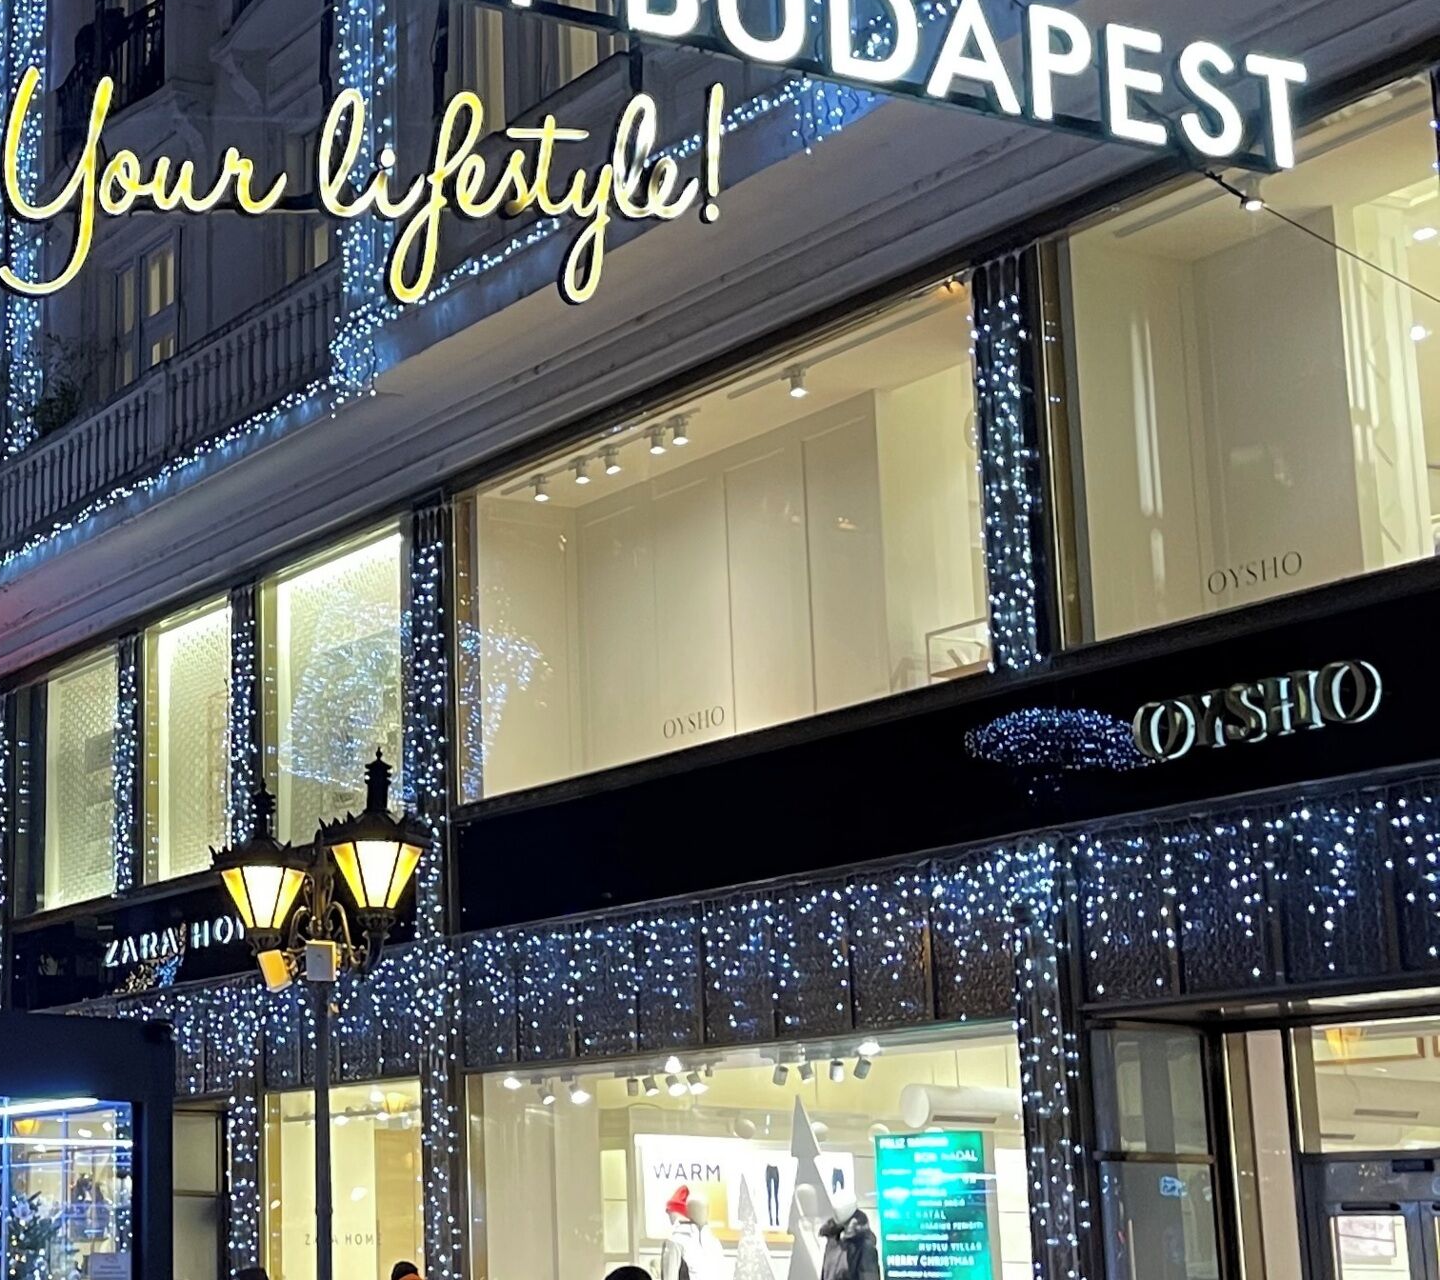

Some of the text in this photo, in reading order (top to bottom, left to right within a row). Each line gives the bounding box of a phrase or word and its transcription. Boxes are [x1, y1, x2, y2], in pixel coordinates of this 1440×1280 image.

[318, 81, 725, 303] lifestyle!
[1207, 550, 1302, 595] OYSHO
[662, 705, 725, 739] OYSHO
[1133, 659, 1382, 760] OYSHO
[105, 926, 180, 968] ZARA
[653, 1163, 721, 1182] WARM
